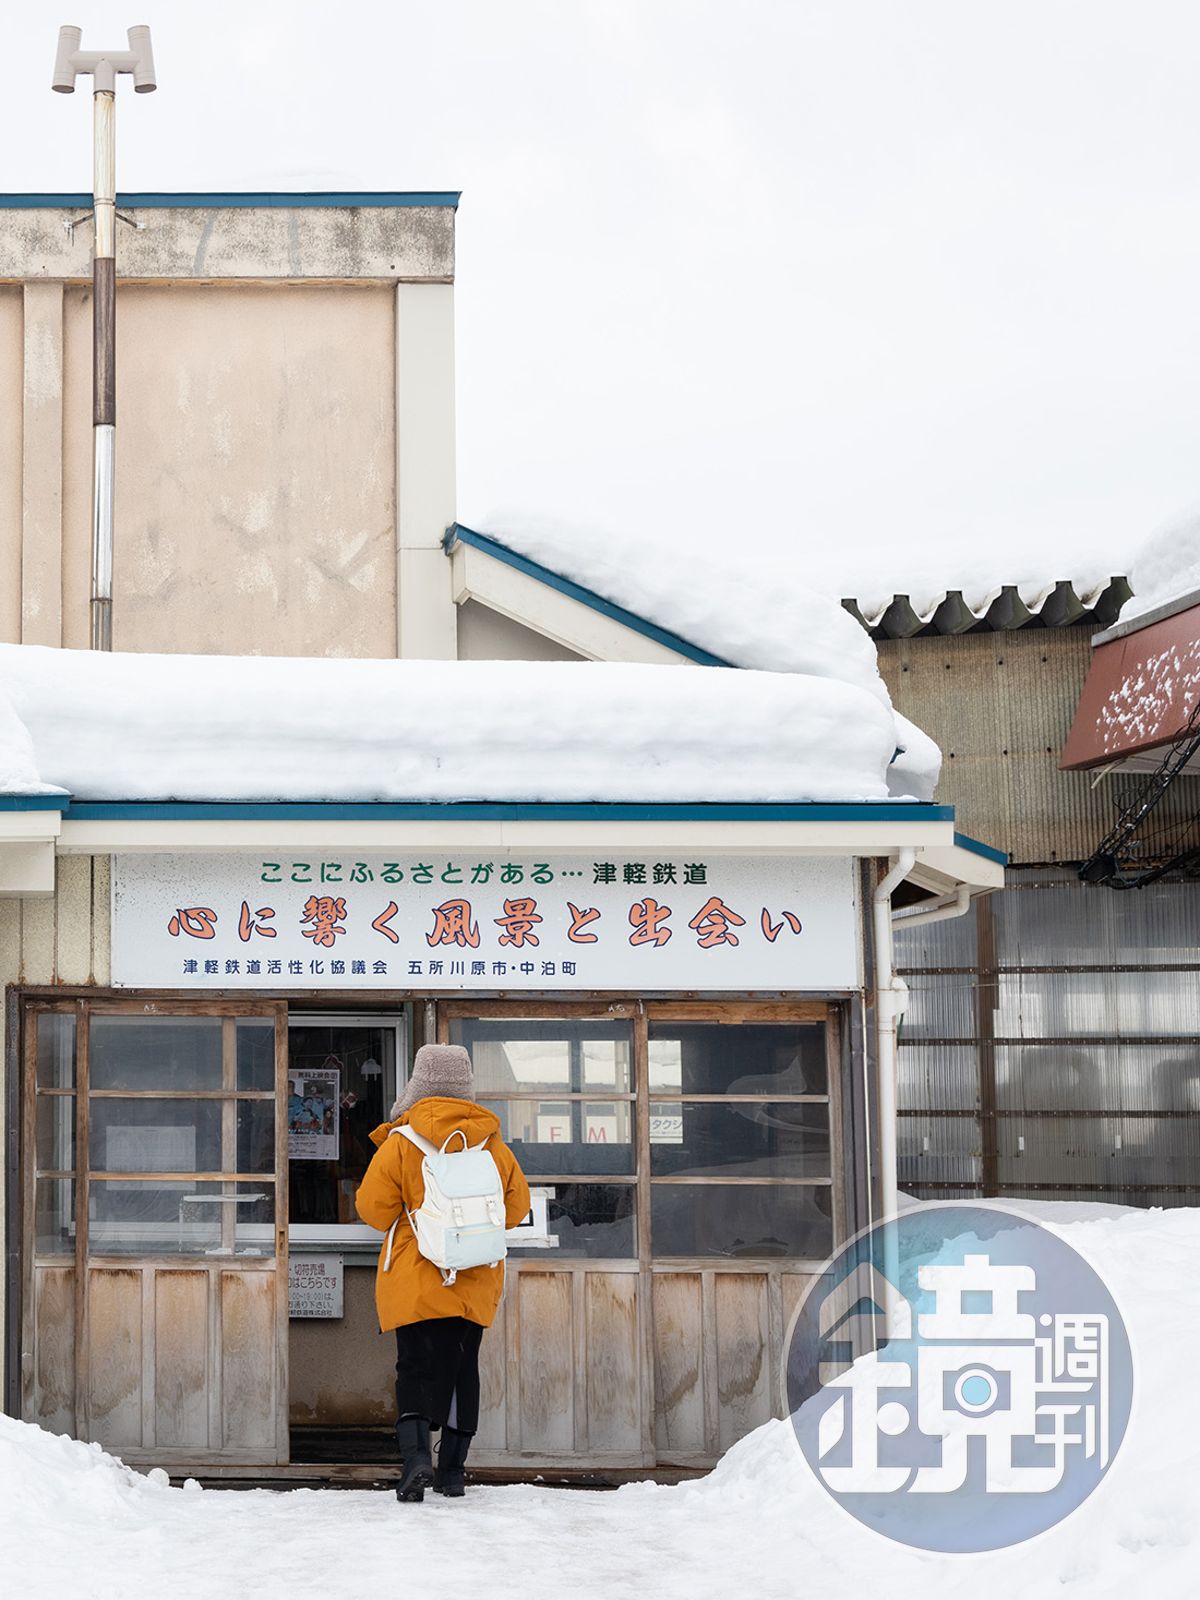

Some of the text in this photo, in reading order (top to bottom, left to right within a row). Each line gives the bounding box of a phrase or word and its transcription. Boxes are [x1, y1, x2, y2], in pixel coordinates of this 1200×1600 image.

[167, 895, 803, 949] 心に響く風景と出会い
[182, 958, 578, 977] 津軽鉄道活性化協議会 五所川原市・中泊町
